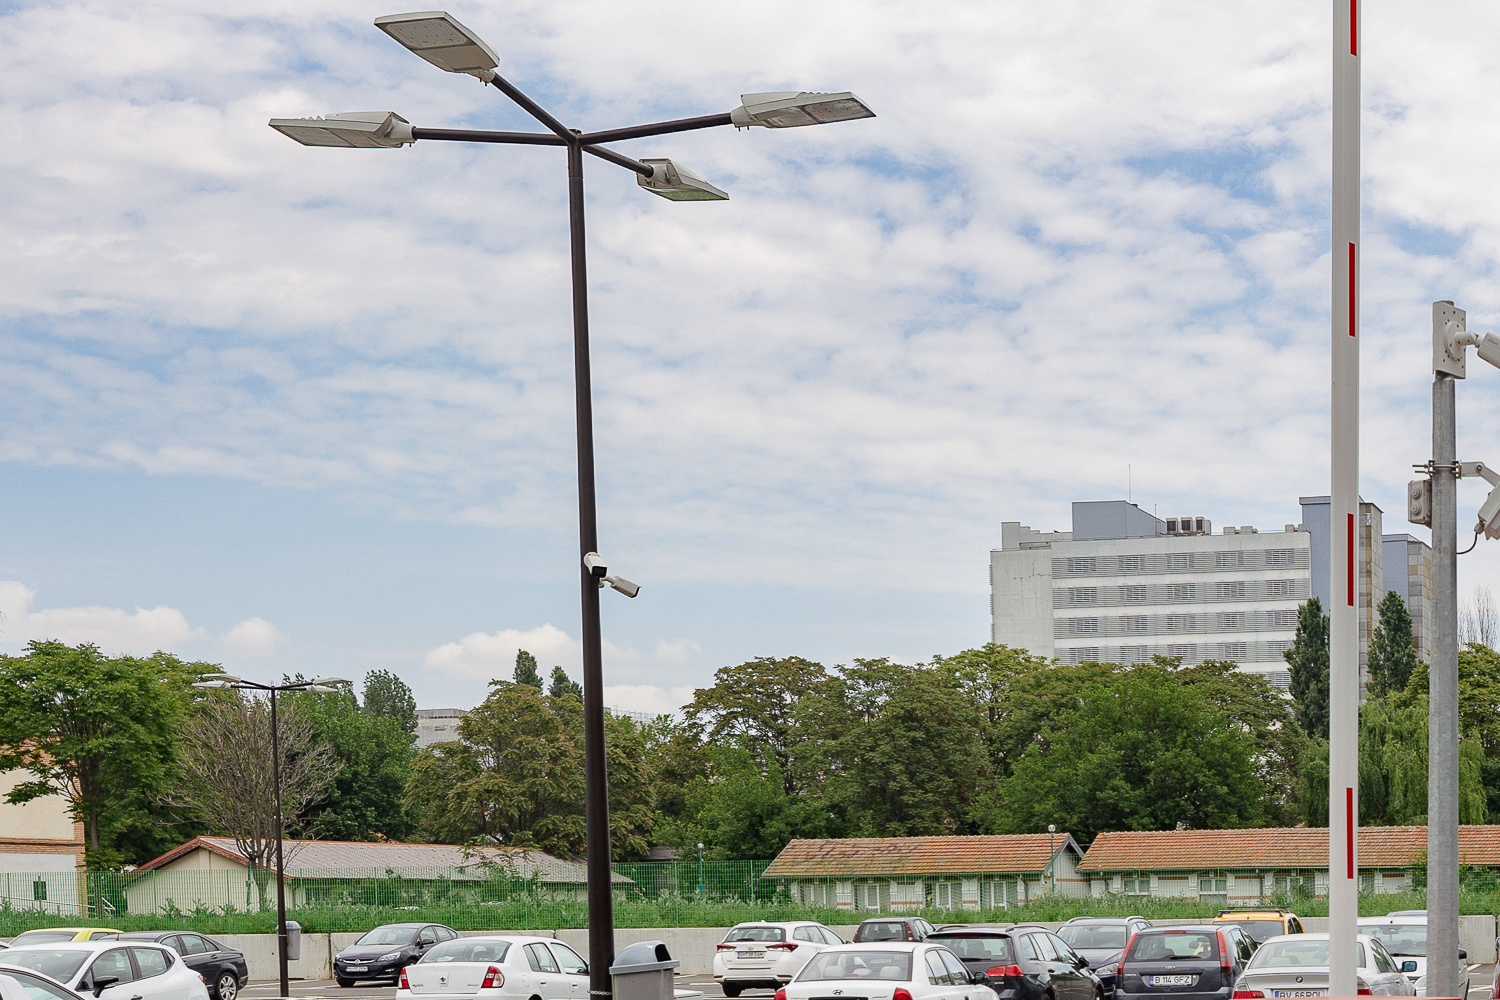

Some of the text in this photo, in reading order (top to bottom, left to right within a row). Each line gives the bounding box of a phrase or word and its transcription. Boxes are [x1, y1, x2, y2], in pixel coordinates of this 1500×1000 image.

[1155, 976, 1190, 984] B 114 GFZ
